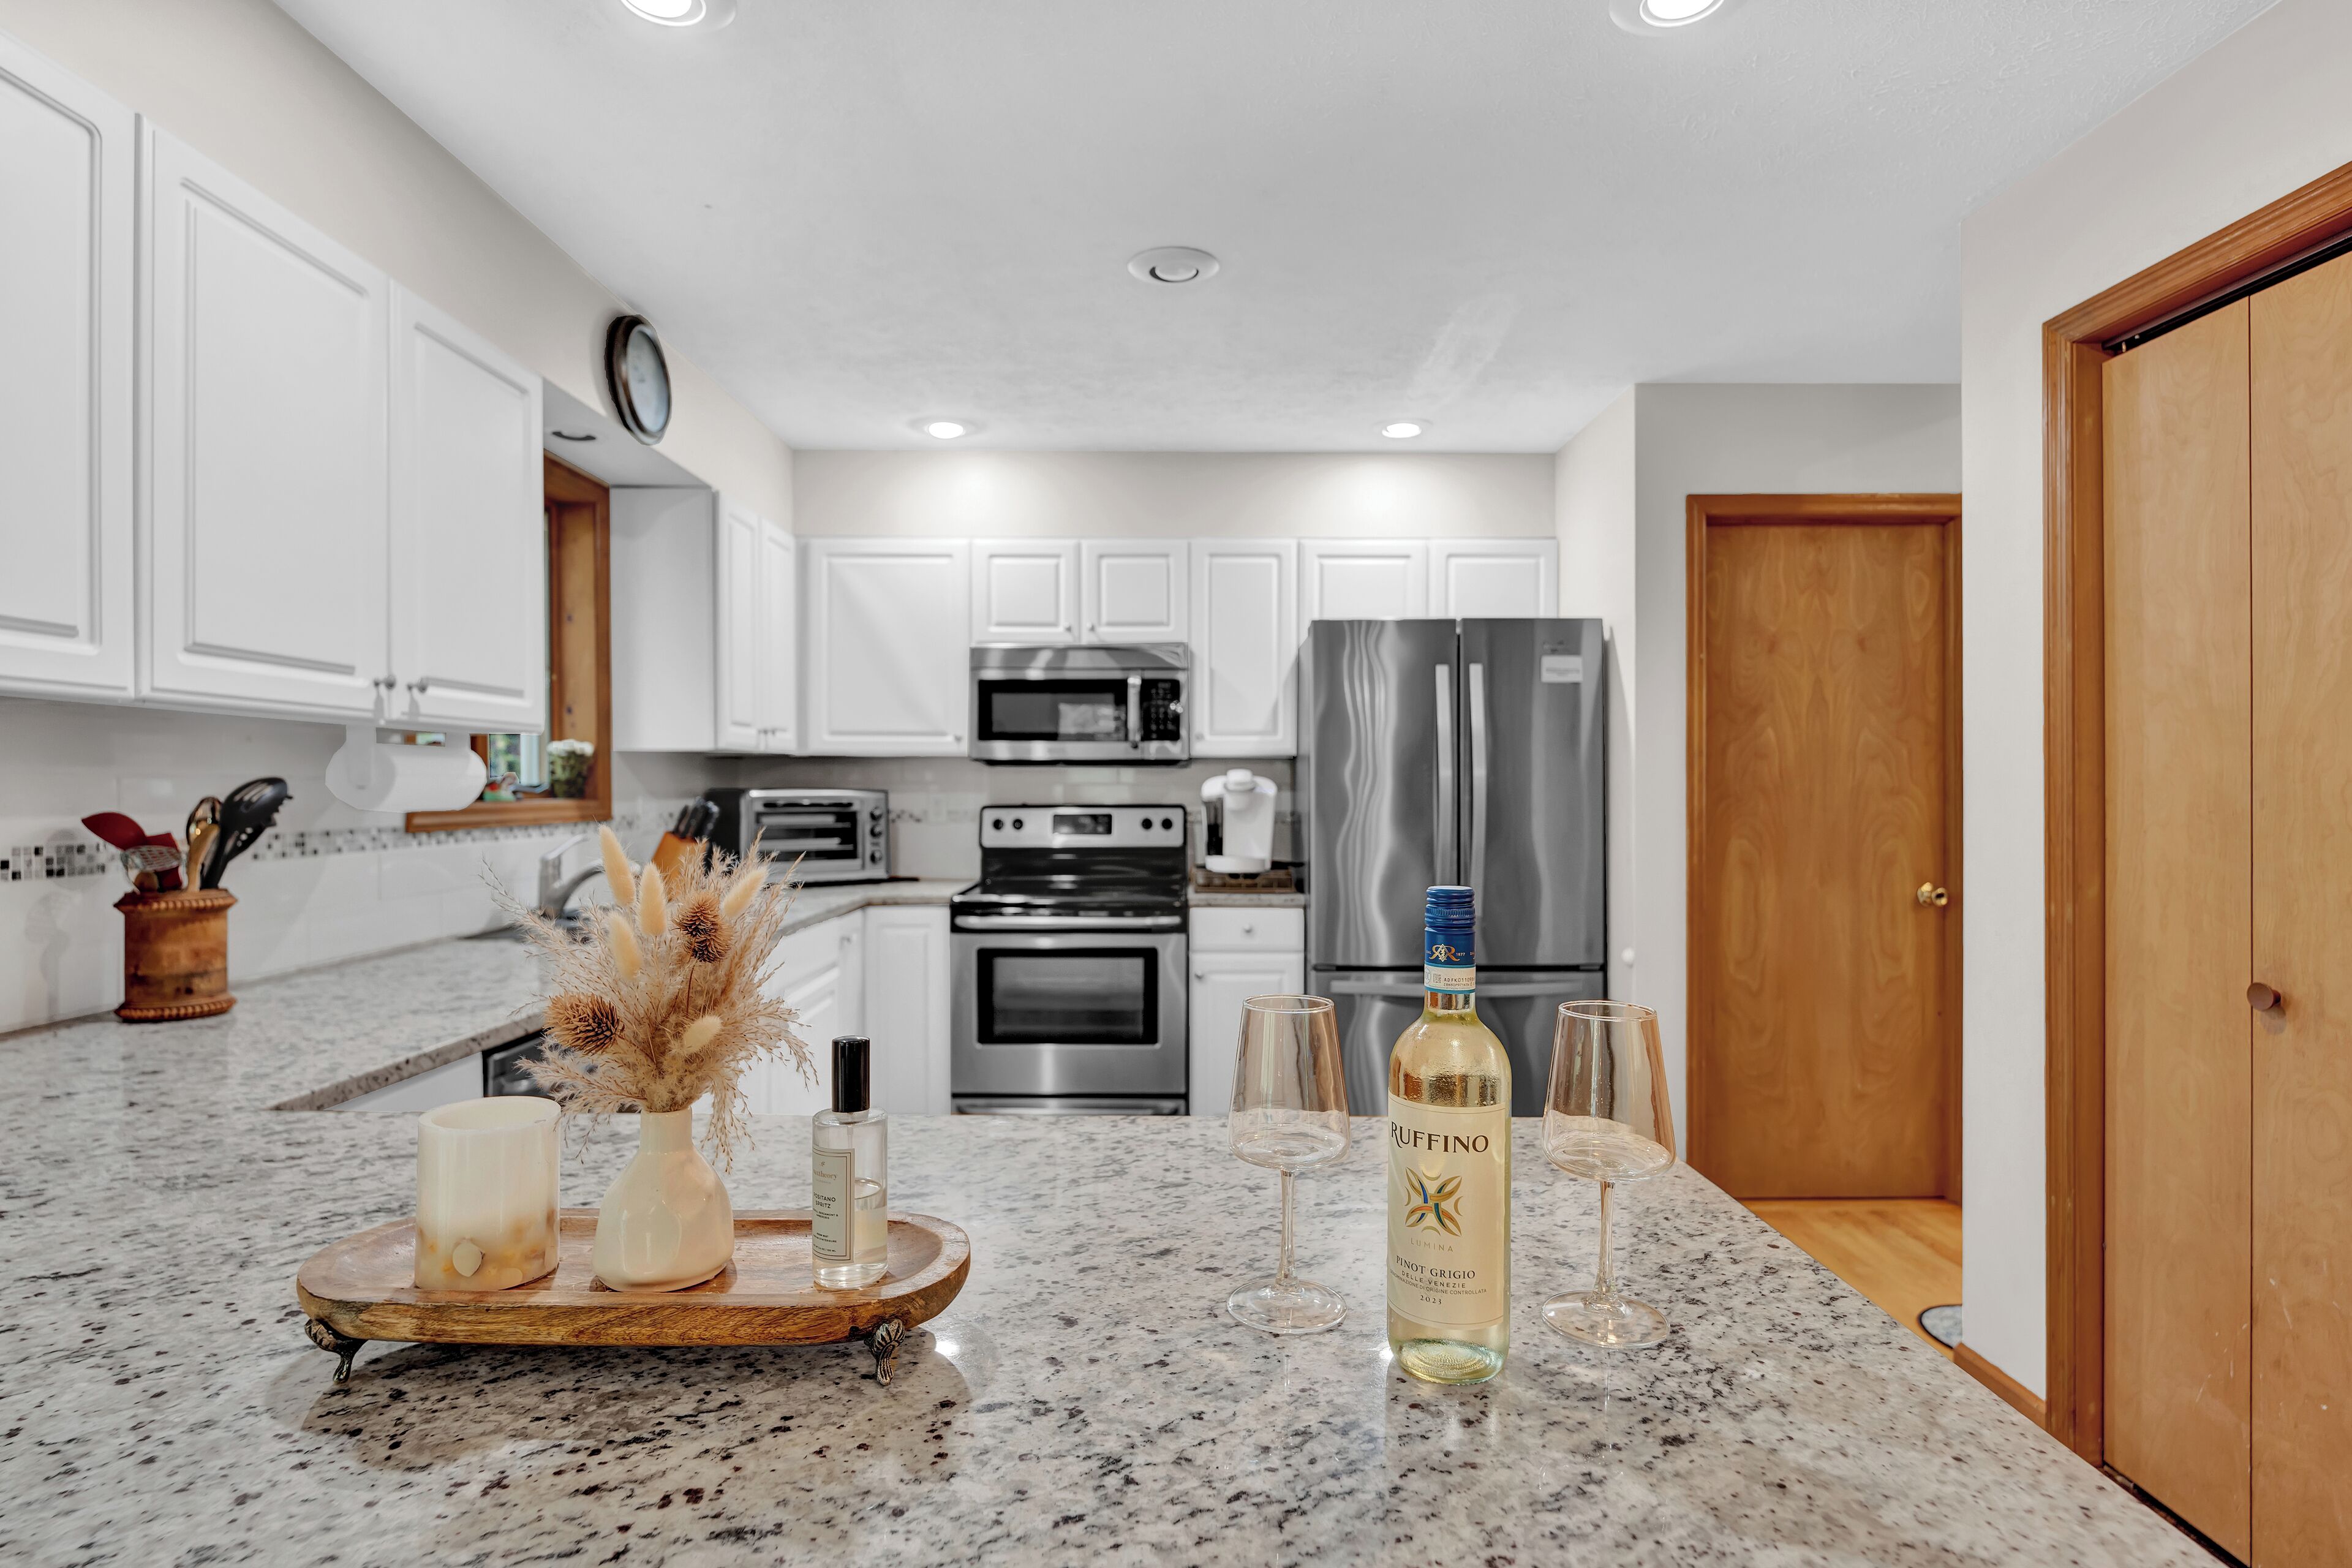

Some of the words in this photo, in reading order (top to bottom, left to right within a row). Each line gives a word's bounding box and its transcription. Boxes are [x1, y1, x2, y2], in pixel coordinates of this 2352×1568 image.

[1391, 1121, 1489, 1153] RUFFINO
[813, 1192, 836, 1202] POSITANO
[1411, 1238, 1453, 1252] LUMINA
[1396, 1255, 1426, 1274] PINOT
[1430, 1268, 1476, 1279] GRIGIO
[1390, 1268, 1419, 1289] DENOMINAZIONE
[1401, 1270, 1423, 1283] DELLE
[1428, 1280, 1466, 1288] VENEZIE
[1420, 1295, 1442, 1305] 2023
